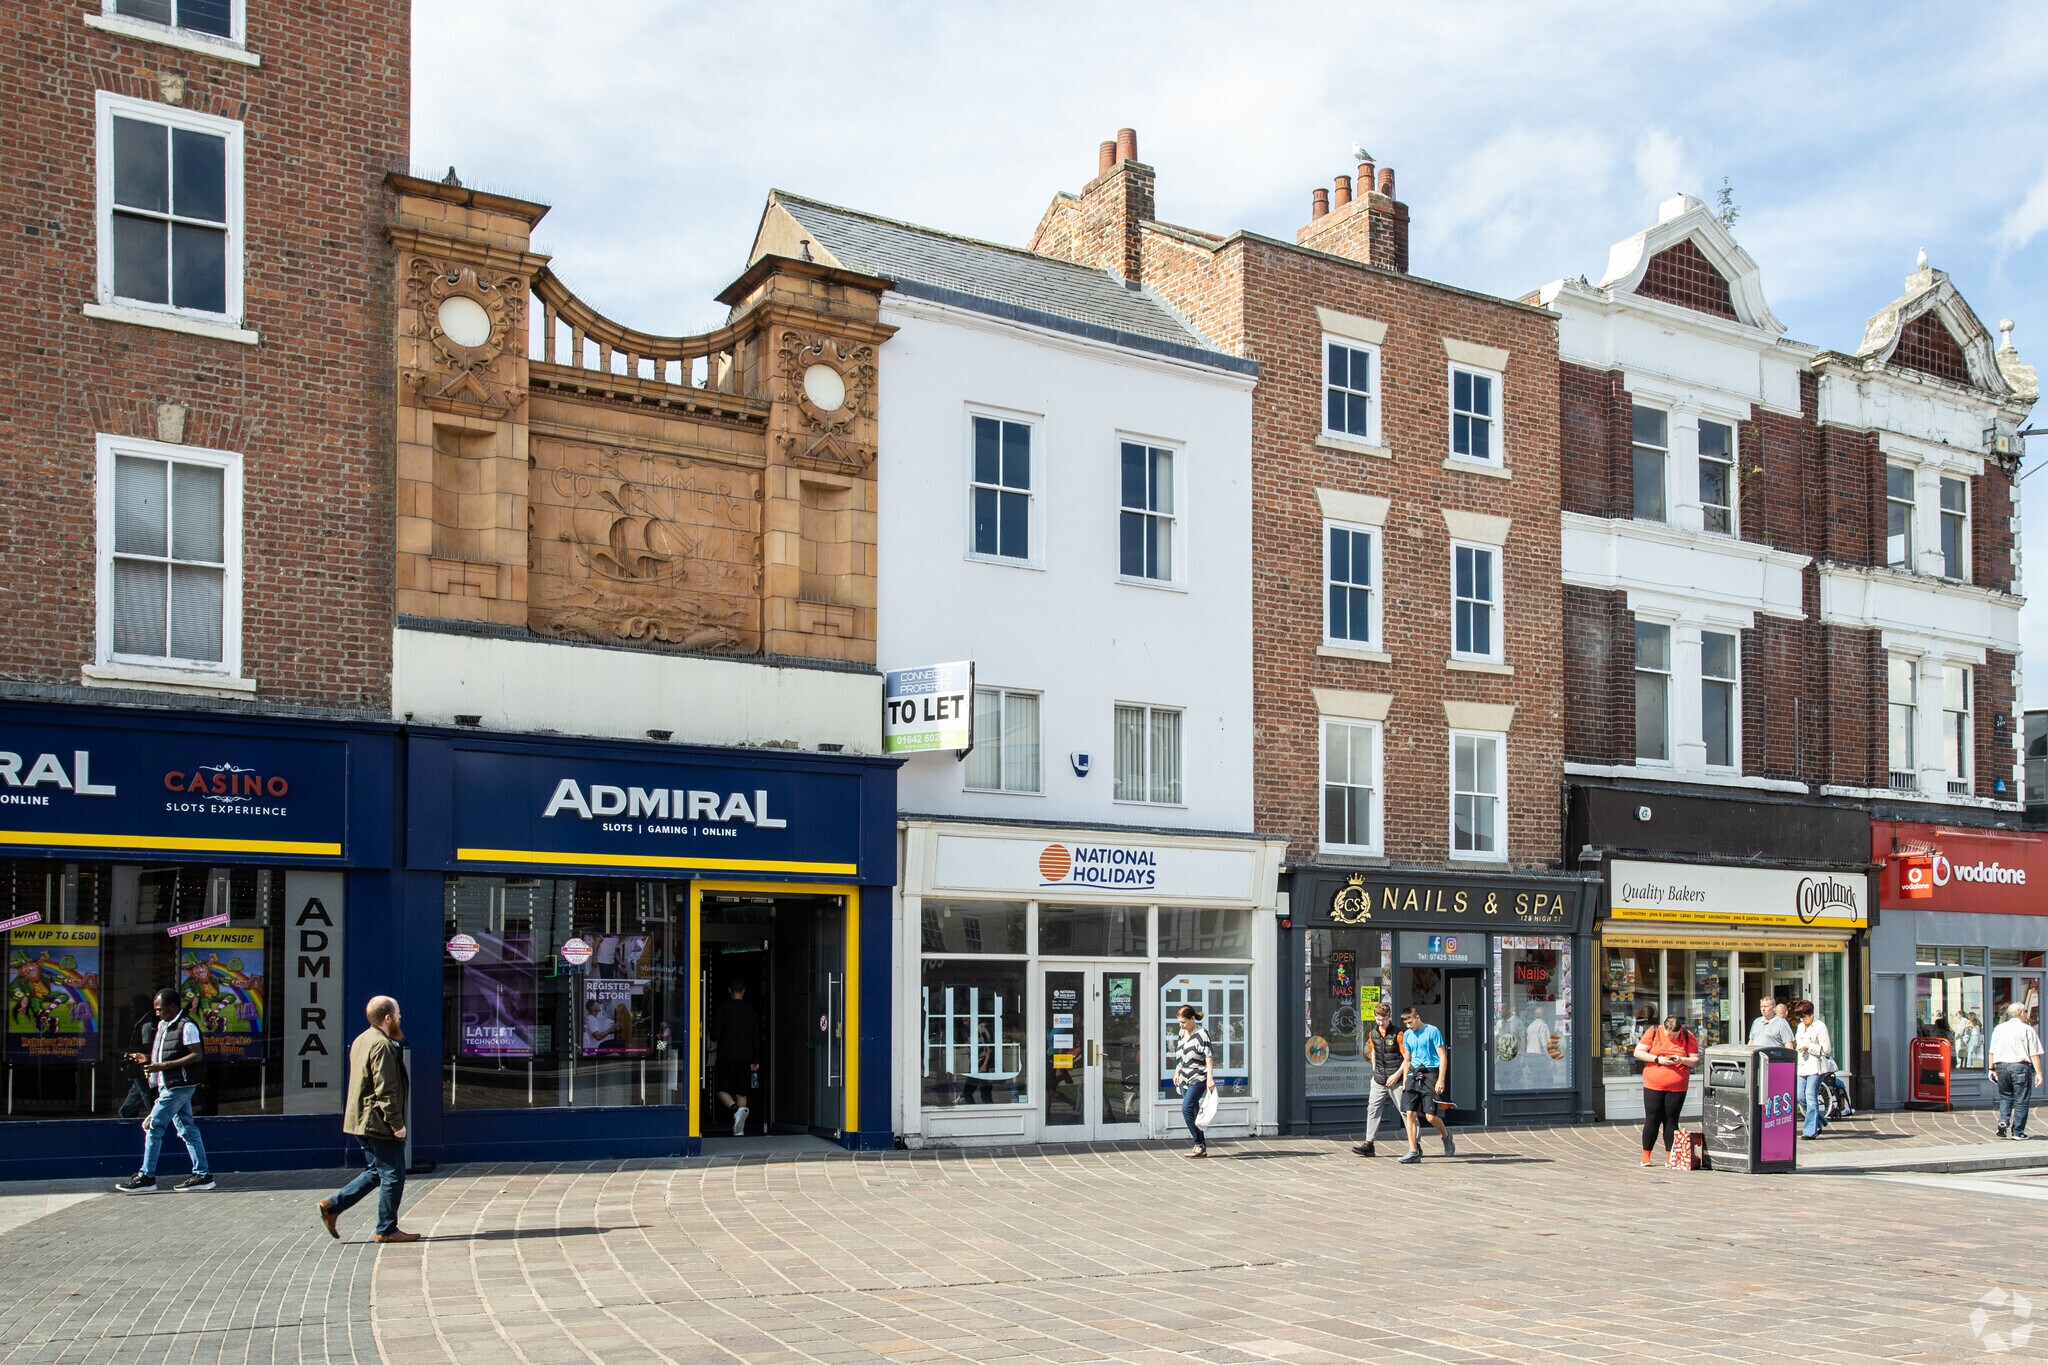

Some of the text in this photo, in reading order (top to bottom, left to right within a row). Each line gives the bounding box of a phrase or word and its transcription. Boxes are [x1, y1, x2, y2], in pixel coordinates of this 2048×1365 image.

[900, 680, 952, 694] PROPERTY
[887, 694, 965, 725] TO LET
[896, 735, 922, 745] 01642
[164, 771, 289, 797] CASINO
[0, 795, 49, 806] ONLINE
[541, 778, 787, 829] ADMIRAL
[166, 803, 287, 816] SLOTS EXPERIENCE
[602, 823, 737, 837] SLOTS GAMING ONLINE
[1075, 847, 1157, 866] NATIONAL
[1073, 866, 1155, 885] HOLIDAYS
[1953, 861, 2026, 885] vodafone
[1622, 883, 1706, 904] Quality Bakers
[1901, 882, 1930, 891] vodafone
[1344, 898, 1361, 912] CS
[1382, 887, 1564, 916] NAILS & SPA
[1796, 876, 1858, 924] Cooplands
[11, 914, 38, 926] ROULETTE
[189, 922, 201, 930] BEST
[202, 915, 228, 927] MACHINES
[14, 931, 97, 940] WIN UP TO £500
[192, 934, 254, 943] PLAY INSIDE
[1332, 952, 1354, 962] OPEN
[1429, 953, 1447, 961] 07425
[1517, 964, 1546, 980] Nails
[295, 898, 334, 1089] ADMIRAL
[586, 982, 631, 991] REGISTER
[1332, 985, 1353, 996] NAILS
[586, 992, 631, 1001] IN STORE
[1340, 1016, 1353, 1027] CS
[466, 1026, 516, 1037] LATEST
[1765, 1092, 1792, 1119] YES
[1764, 1118, 1776, 1129] MORE
[1782, 1115, 1792, 1125] COME
